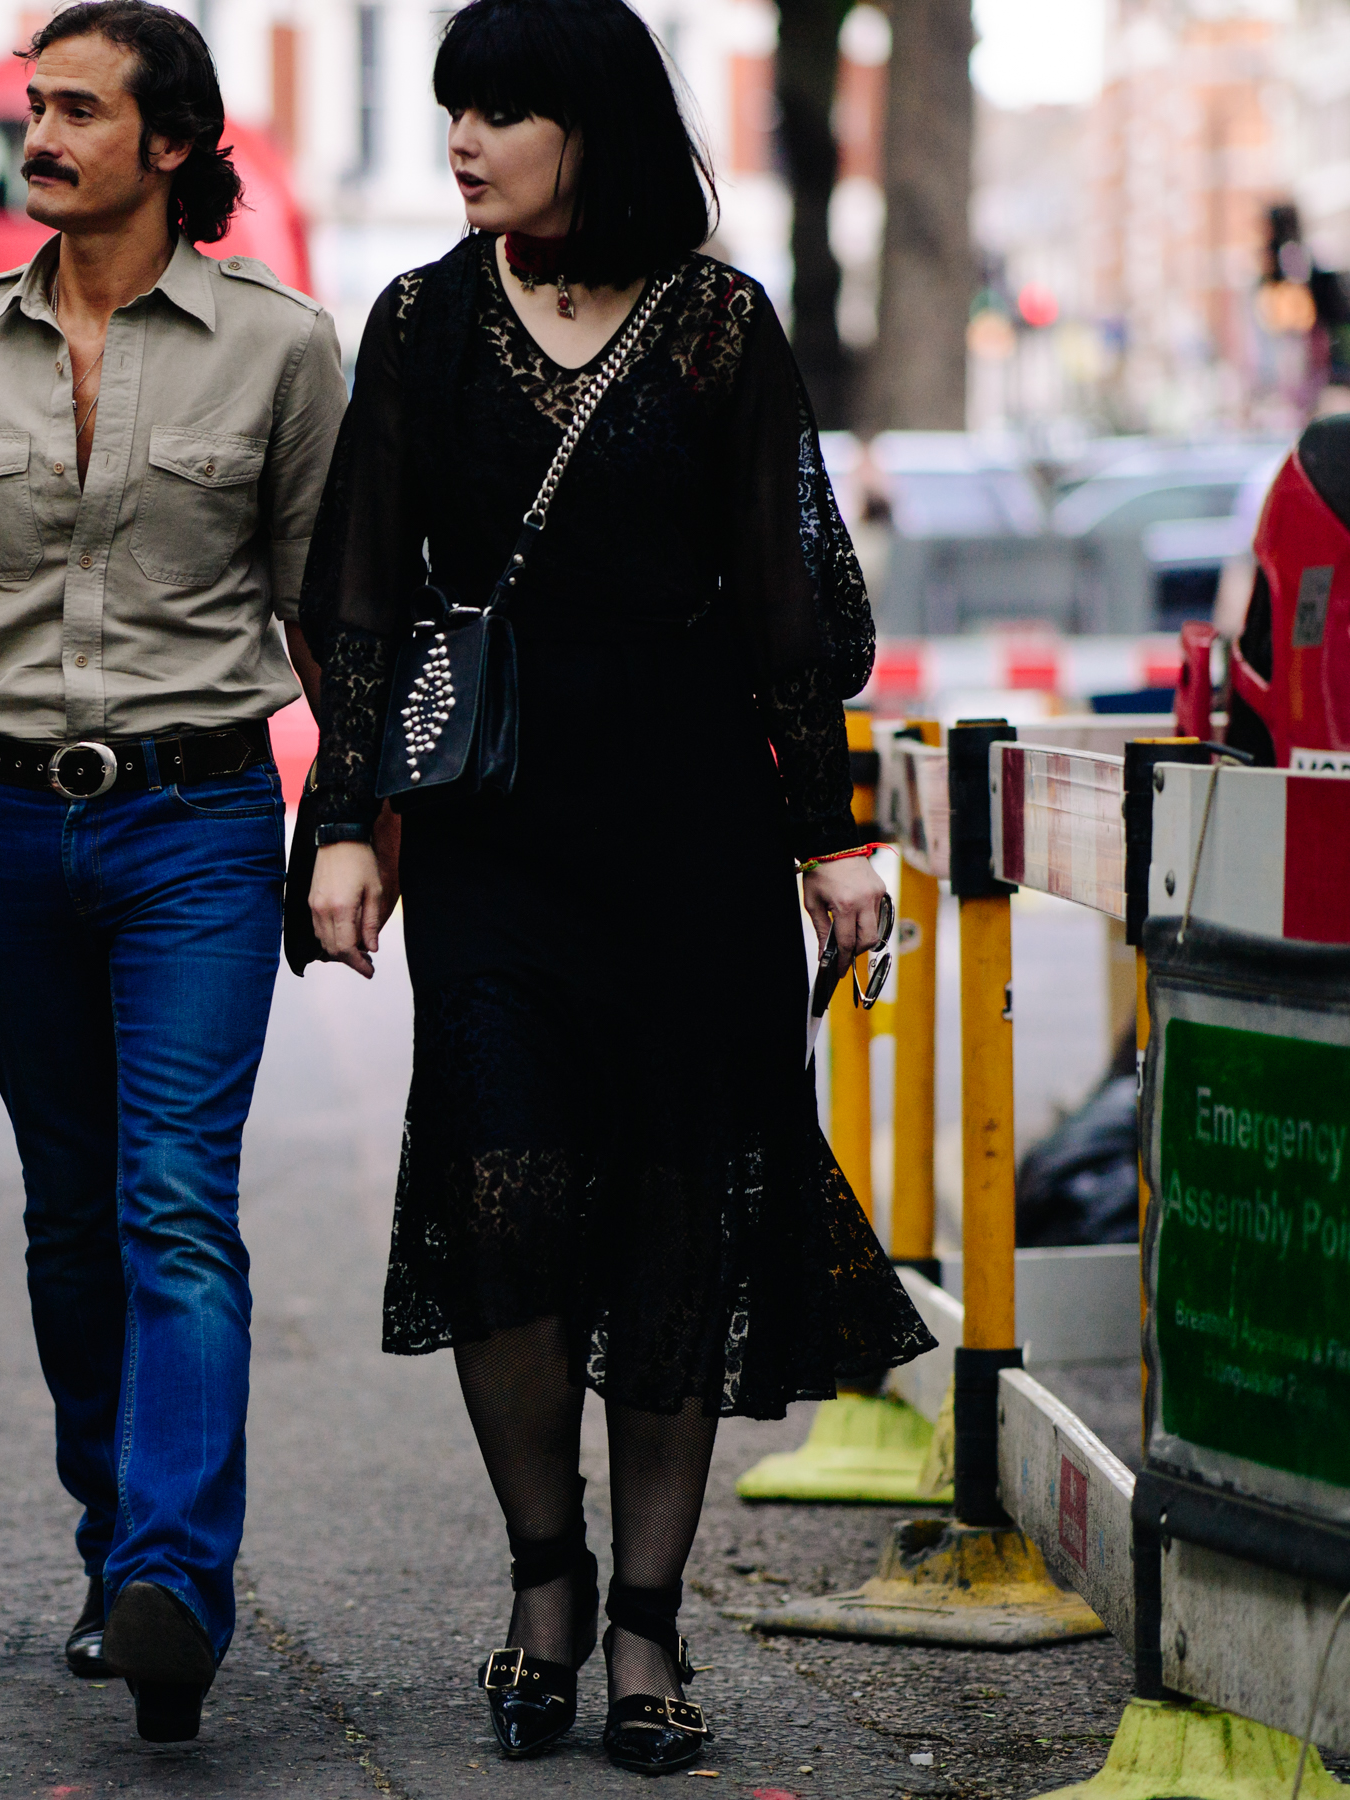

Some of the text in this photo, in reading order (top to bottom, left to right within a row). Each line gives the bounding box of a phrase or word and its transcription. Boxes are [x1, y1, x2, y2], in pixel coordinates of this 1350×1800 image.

[1196, 1085, 1348, 1183] Emergency
[1163, 1168, 1350, 1262] Assembly Poi
